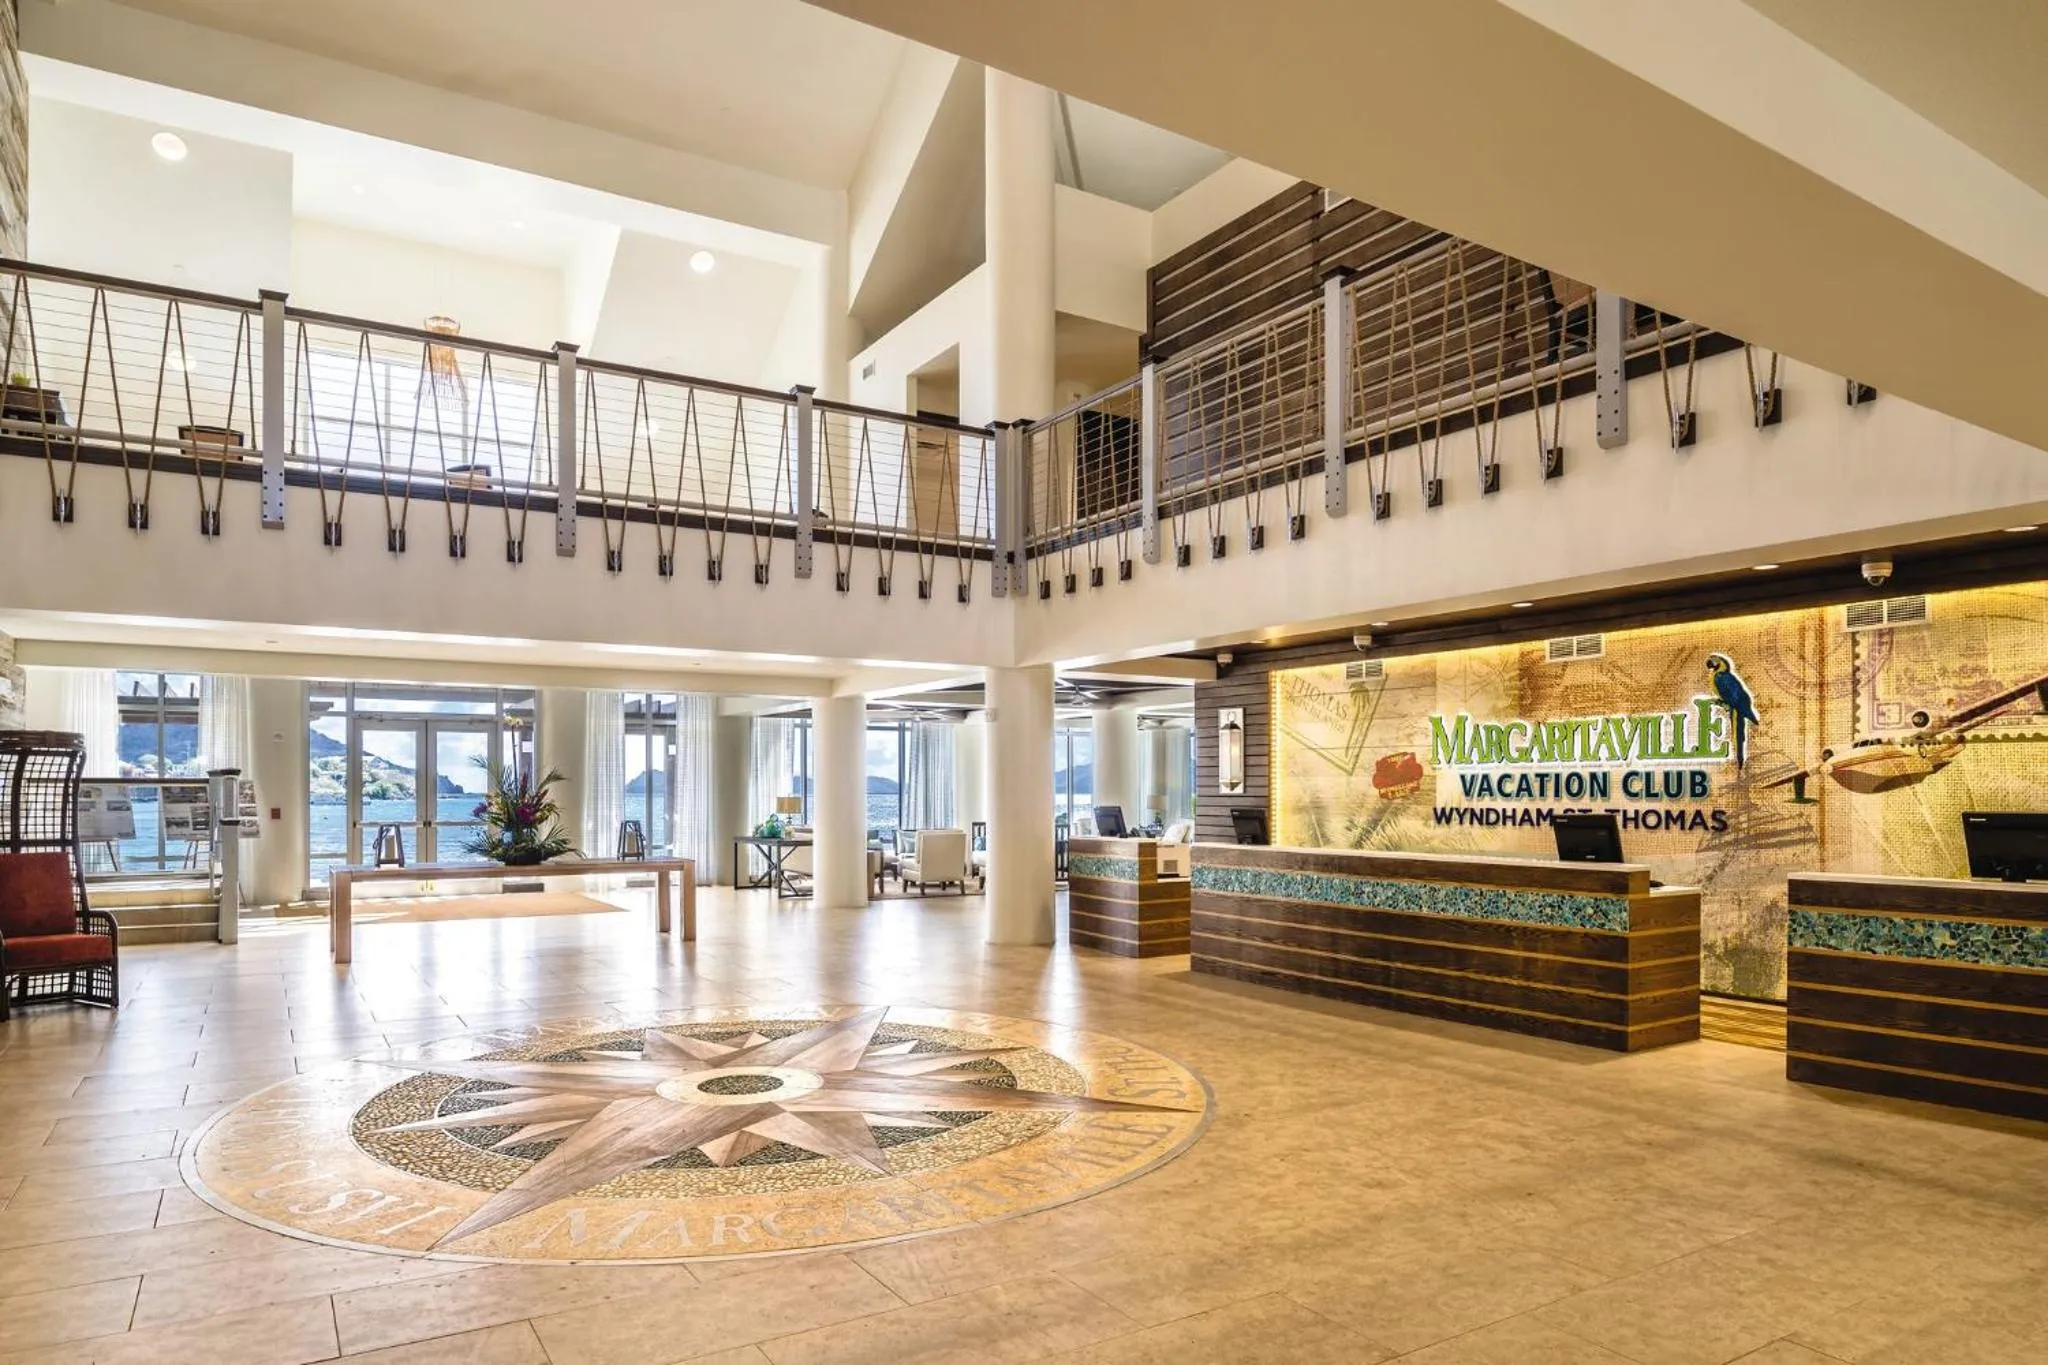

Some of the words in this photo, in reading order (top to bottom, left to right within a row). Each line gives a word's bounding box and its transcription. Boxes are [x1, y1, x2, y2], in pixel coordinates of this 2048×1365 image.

[1428, 698, 1730, 765] MARGARITAVILLE
[1459, 770, 1610, 799] VACATION
[1621, 769, 1711, 799] CLUB
[1433, 806, 1554, 827] WYNDHAM
[1605, 808, 1729, 833] HOMAS
